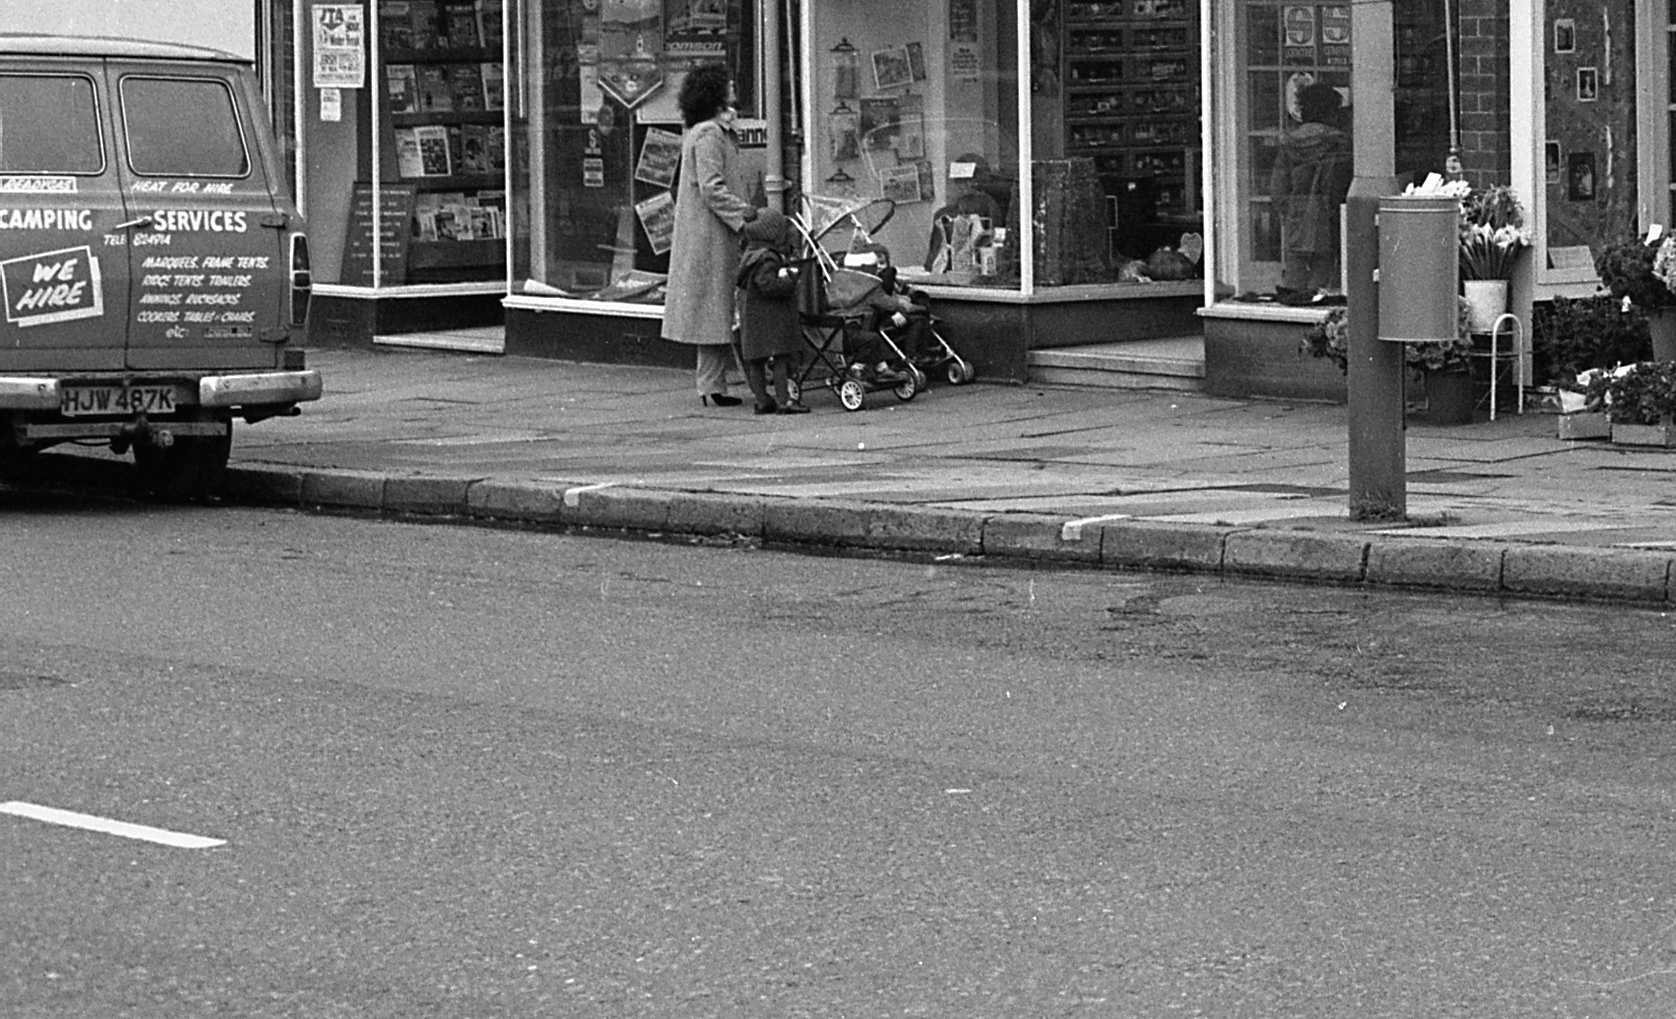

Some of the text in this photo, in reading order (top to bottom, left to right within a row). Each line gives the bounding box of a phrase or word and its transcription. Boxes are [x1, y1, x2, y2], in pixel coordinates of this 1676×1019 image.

[131, 181, 166, 192] HEAT
[171, 181, 198, 193] FOR
[203, 183, 234, 194] HIRE
[0, 209, 247, 232] CAMPING SERVICES
[33, 259, 77, 283] WE
[16, 281, 86, 311] HIRE
[65, 388, 173, 412] HJW 487K
